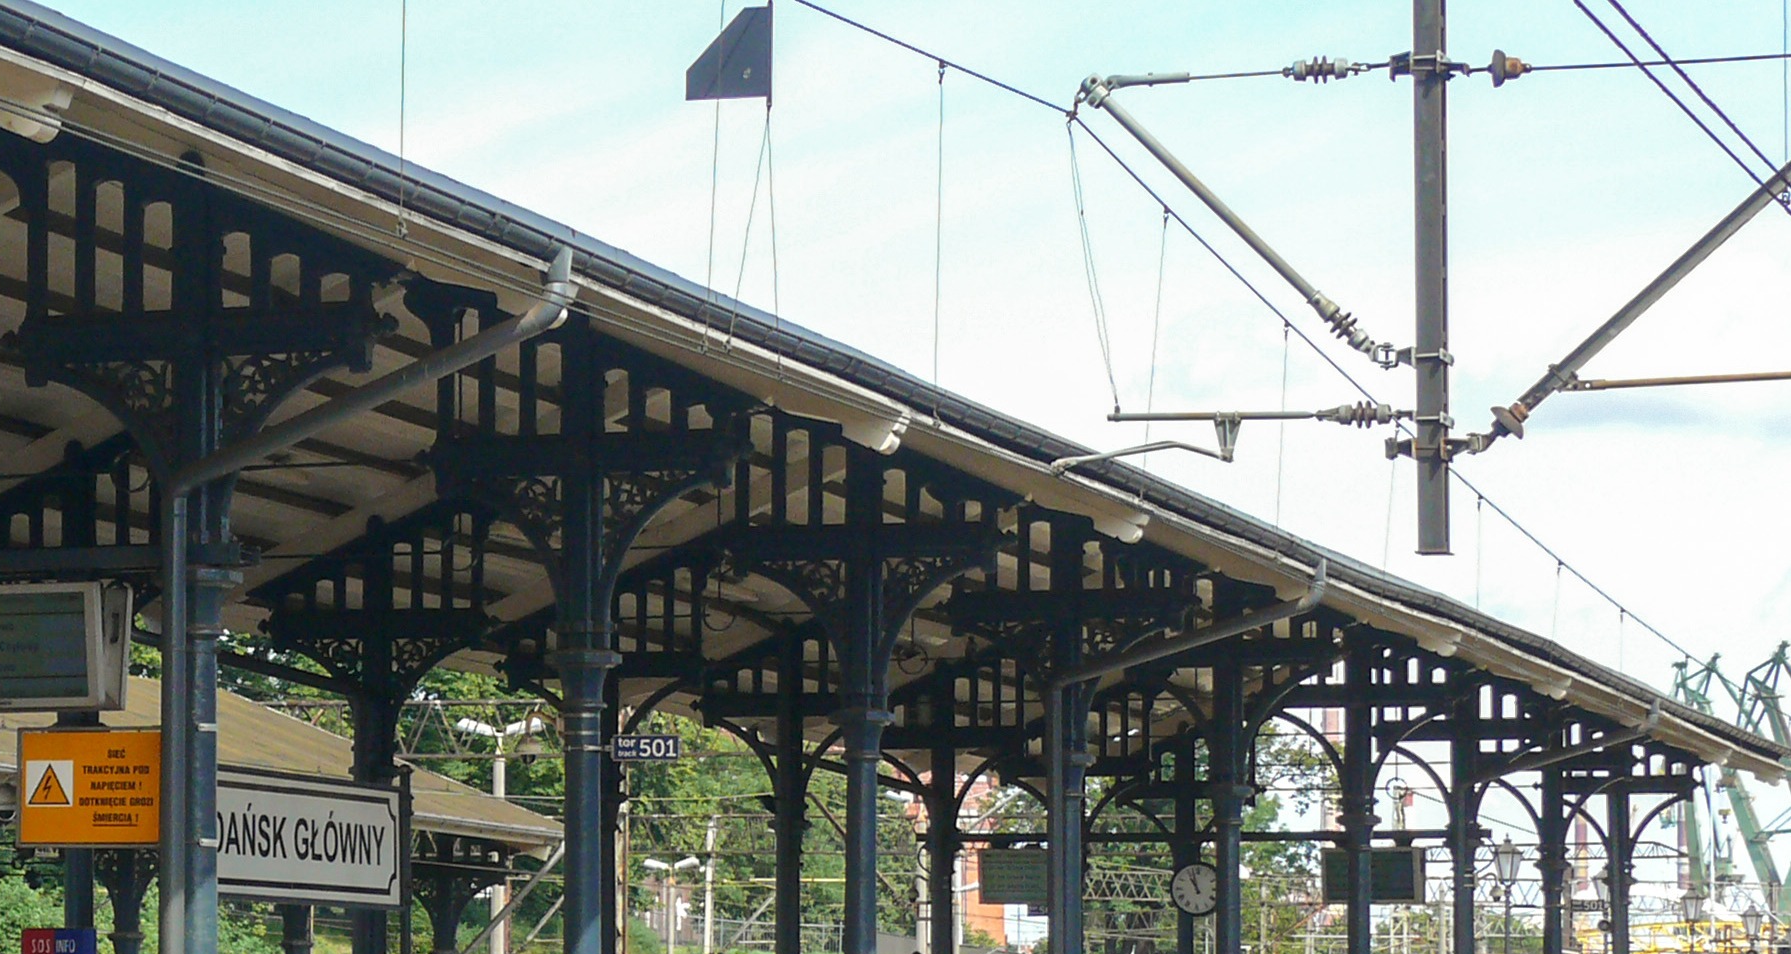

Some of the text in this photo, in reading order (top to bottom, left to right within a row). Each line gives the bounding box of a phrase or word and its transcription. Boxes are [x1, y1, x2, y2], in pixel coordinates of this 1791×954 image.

[617, 738, 677, 757] tor 501
[82, 765, 150, 775] TRAKCYJNA POD
[217, 802, 385, 866] AŃSK GŁÓWNY
[31, 939, 76, 953] SOS INFO
